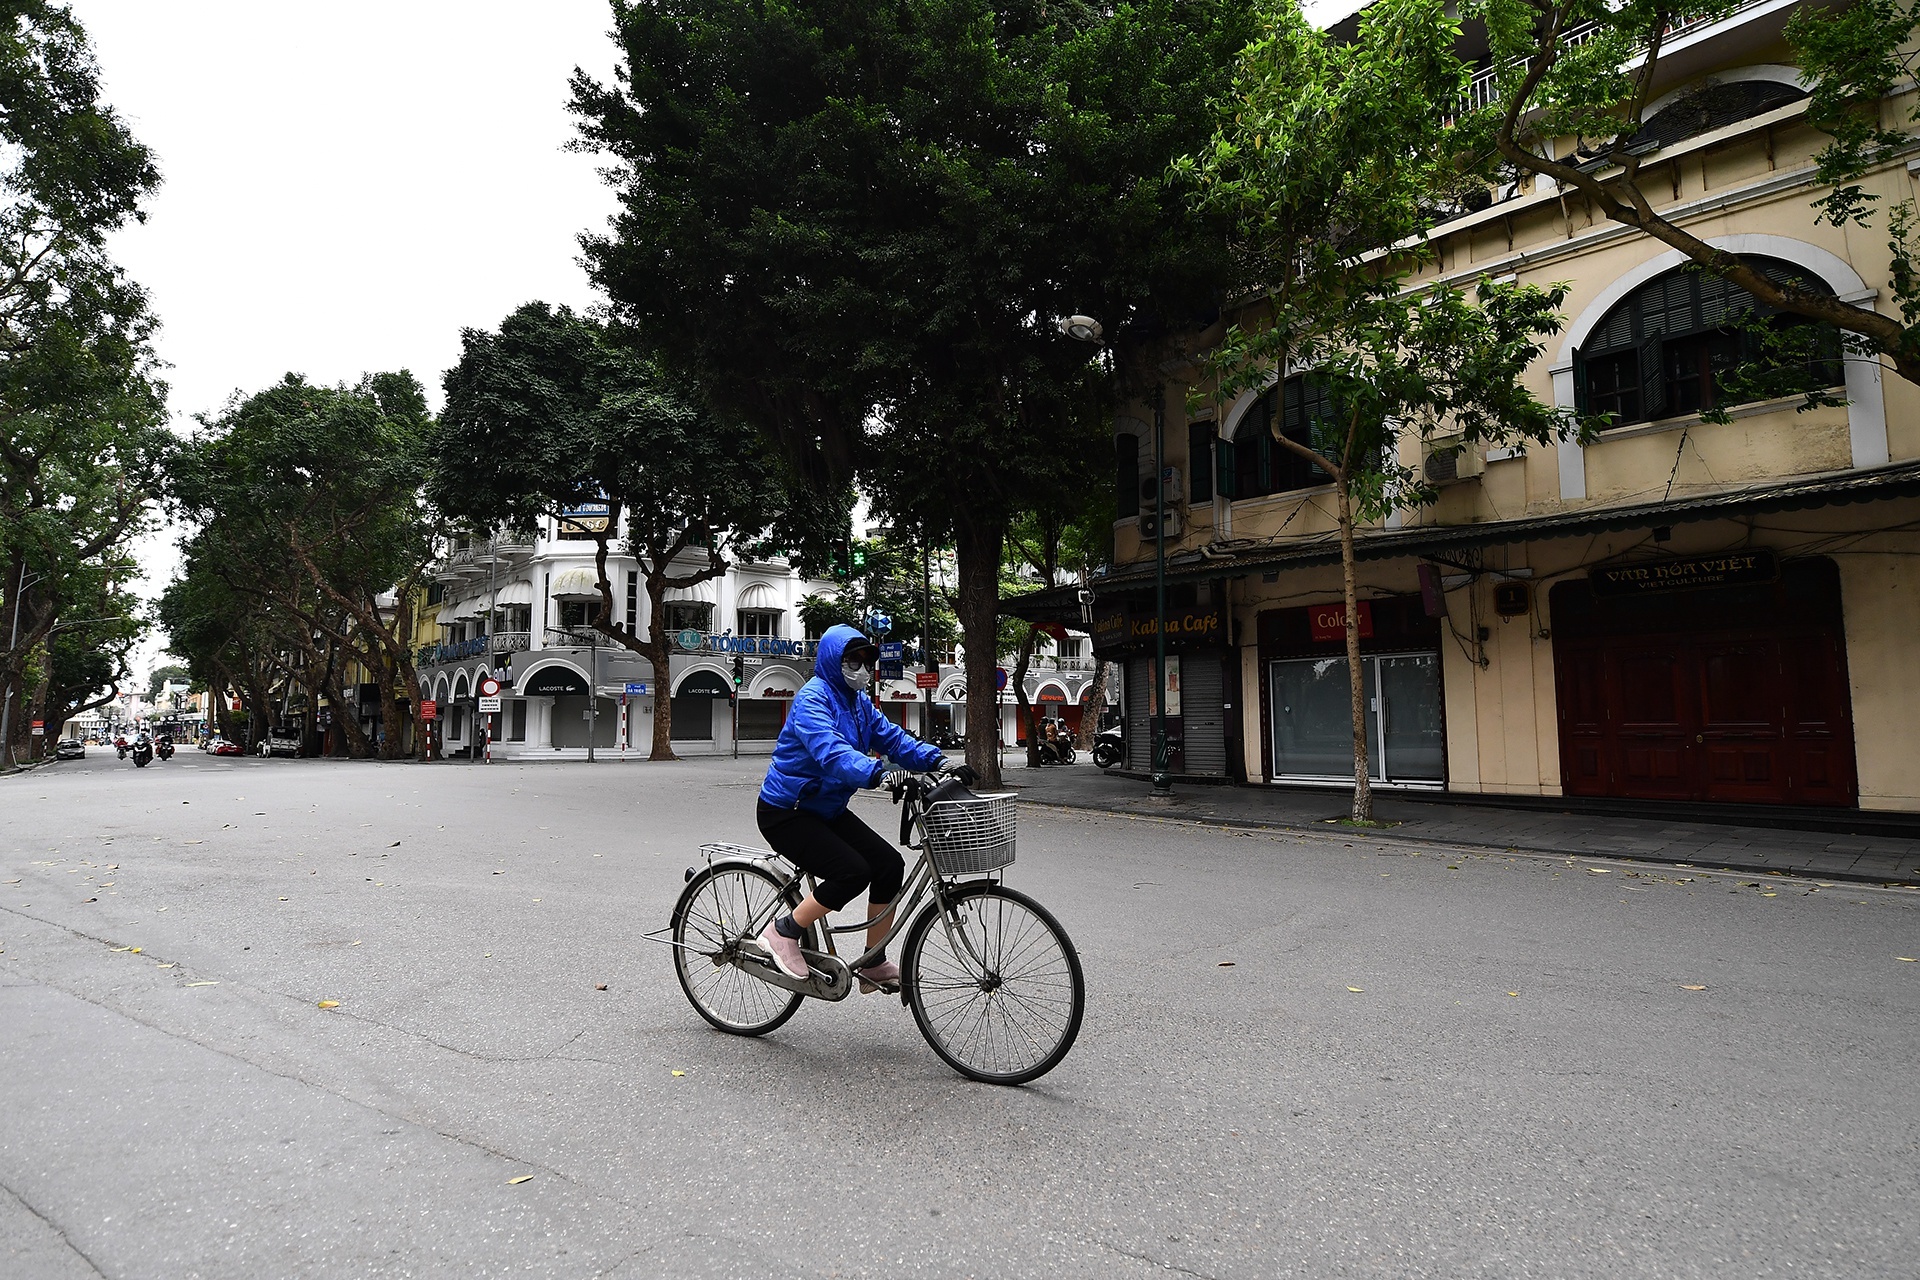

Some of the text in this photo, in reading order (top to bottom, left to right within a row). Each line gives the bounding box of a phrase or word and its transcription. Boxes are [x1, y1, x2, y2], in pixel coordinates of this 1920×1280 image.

[1654, 562, 1697, 579] HÓA
[1700, 556, 1756, 573] VIỆT
[1183, 611, 1218, 634] Café
[1317, 611, 1363, 628] Color
[709, 628, 755, 653] TỔNG
[760, 635, 803, 655] CÔNG
